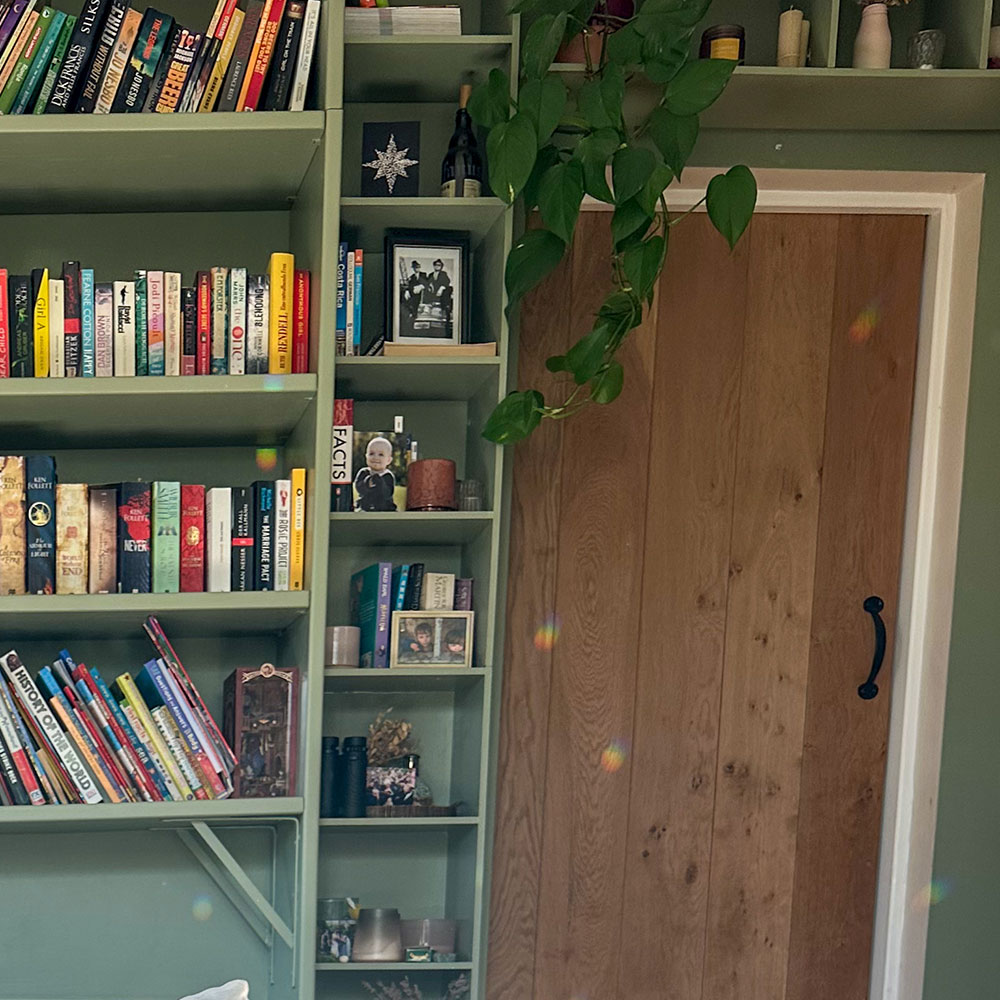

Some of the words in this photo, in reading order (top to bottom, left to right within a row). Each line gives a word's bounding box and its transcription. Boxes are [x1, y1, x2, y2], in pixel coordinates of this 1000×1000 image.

[80, 0, 101, 34] SILKS
[101, 6, 124, 46] CHILD
[287, 22, 295, 38] TRAIN
[260, 21, 273, 46] BEFORE
[264, 34, 275, 54] BEERS
[90, 45, 109, 83] WITHOUT
[112, 53, 126, 68] JO
[51, 80, 66, 107] DICK
[61, 45, 80, 80] FRANCIS
[133, 72, 143, 82] JO
[231, 61, 242, 88] LAURENCE
[83, 82, 97, 100] FAIL
[159, 69, 187, 108] BEER
[82, 273, 92, 306] FEARNE
[150, 278, 160, 300] Jodi
[337, 264, 345, 288] Costa
[36, 297, 46, 318] Girl
[336, 290, 344, 308] Rica
[83, 308, 92, 346] COTTON
[97, 315, 105, 348] BROWN
[151, 302, 162, 338] Picoult
[277, 314, 287, 353] RENDELL
[70, 336, 78, 365] FITZEK
[232, 326, 244, 361] One
[97, 349, 105, 368] DAN
[332, 428, 346, 480] FACTS
[124, 540, 148, 552] NEVER
[261, 525, 270, 562] MARRIAGE
[278, 542, 288, 568] PROJECT
[62, 568, 82, 576] END
[261, 564, 270, 582] PACT
[14, 670, 45, 713] HISTORY
[42, 714, 56, 731] OF
[50, 731, 69, 753] THE
[65, 752, 92, 790] WORLD
